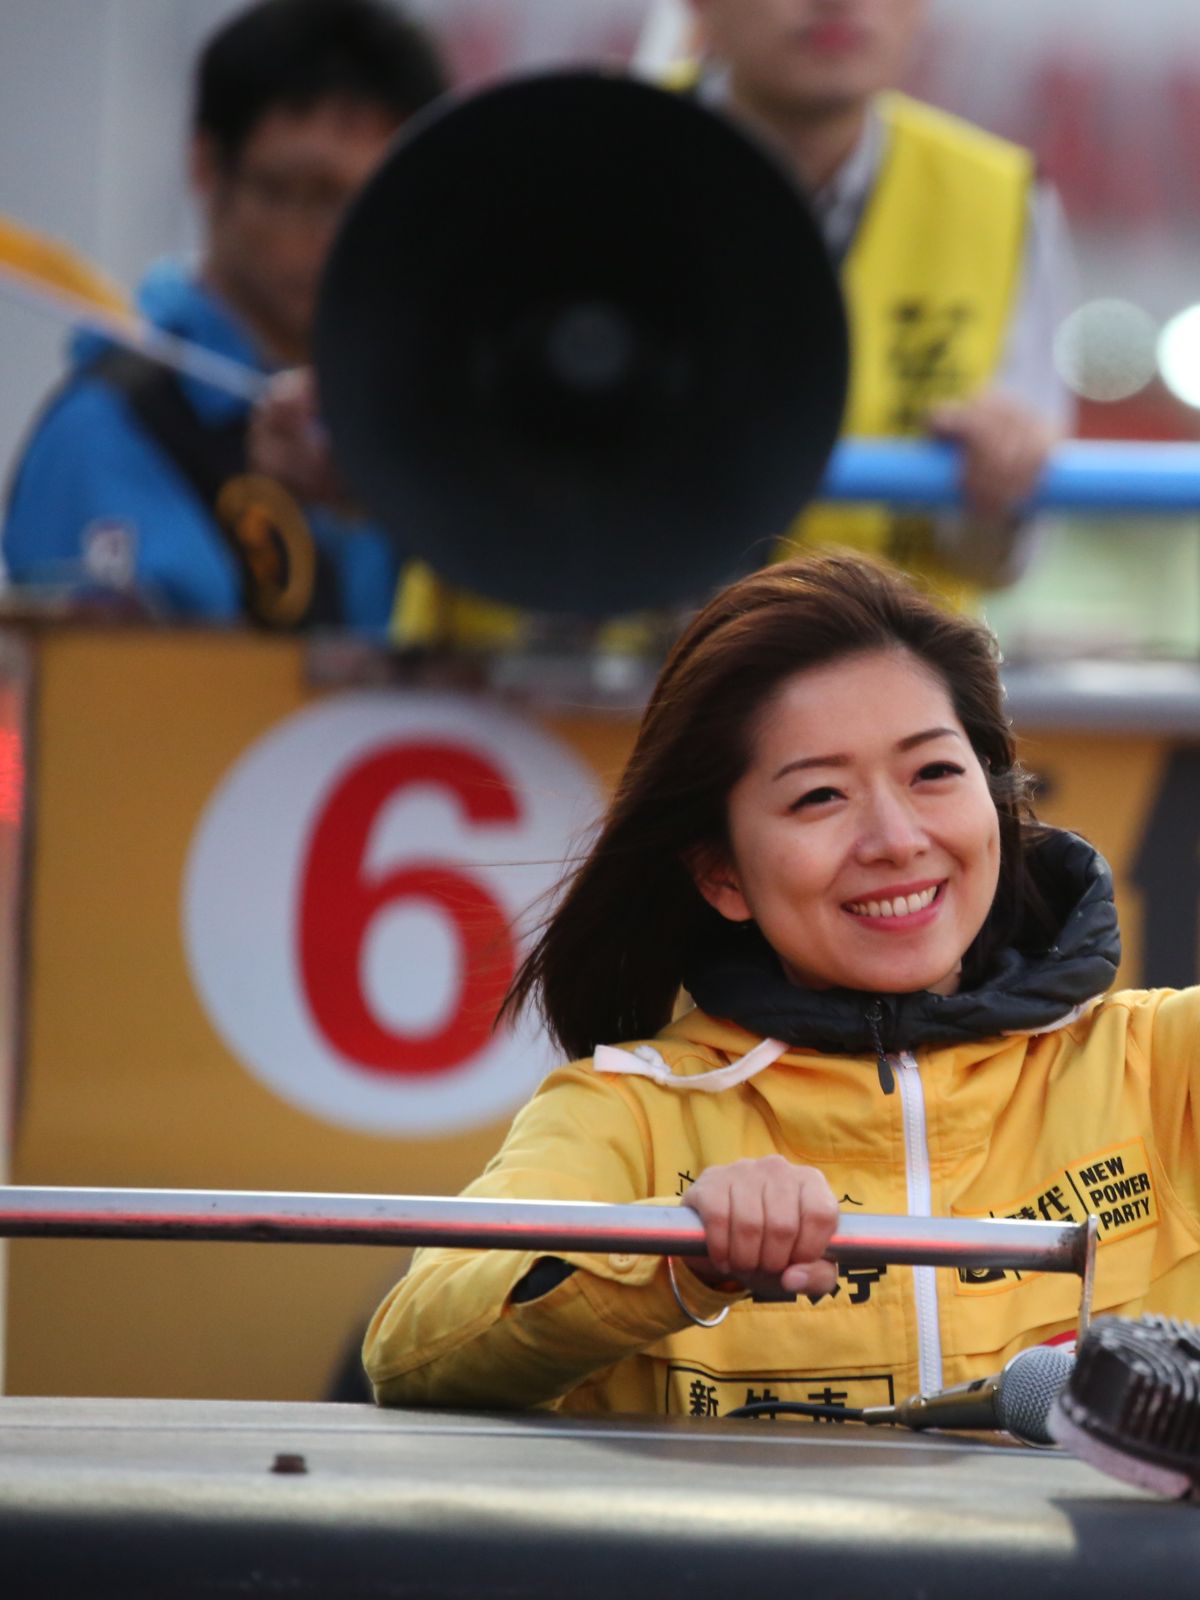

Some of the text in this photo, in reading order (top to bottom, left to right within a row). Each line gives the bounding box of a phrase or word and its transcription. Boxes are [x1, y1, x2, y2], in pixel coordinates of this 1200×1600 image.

[295, 736, 524, 1083] 6
[1079, 1156, 1125, 1187] NEW
[1089, 1172, 1150, 1208] POWER
[1099, 1197, 1150, 1231] PARTY
